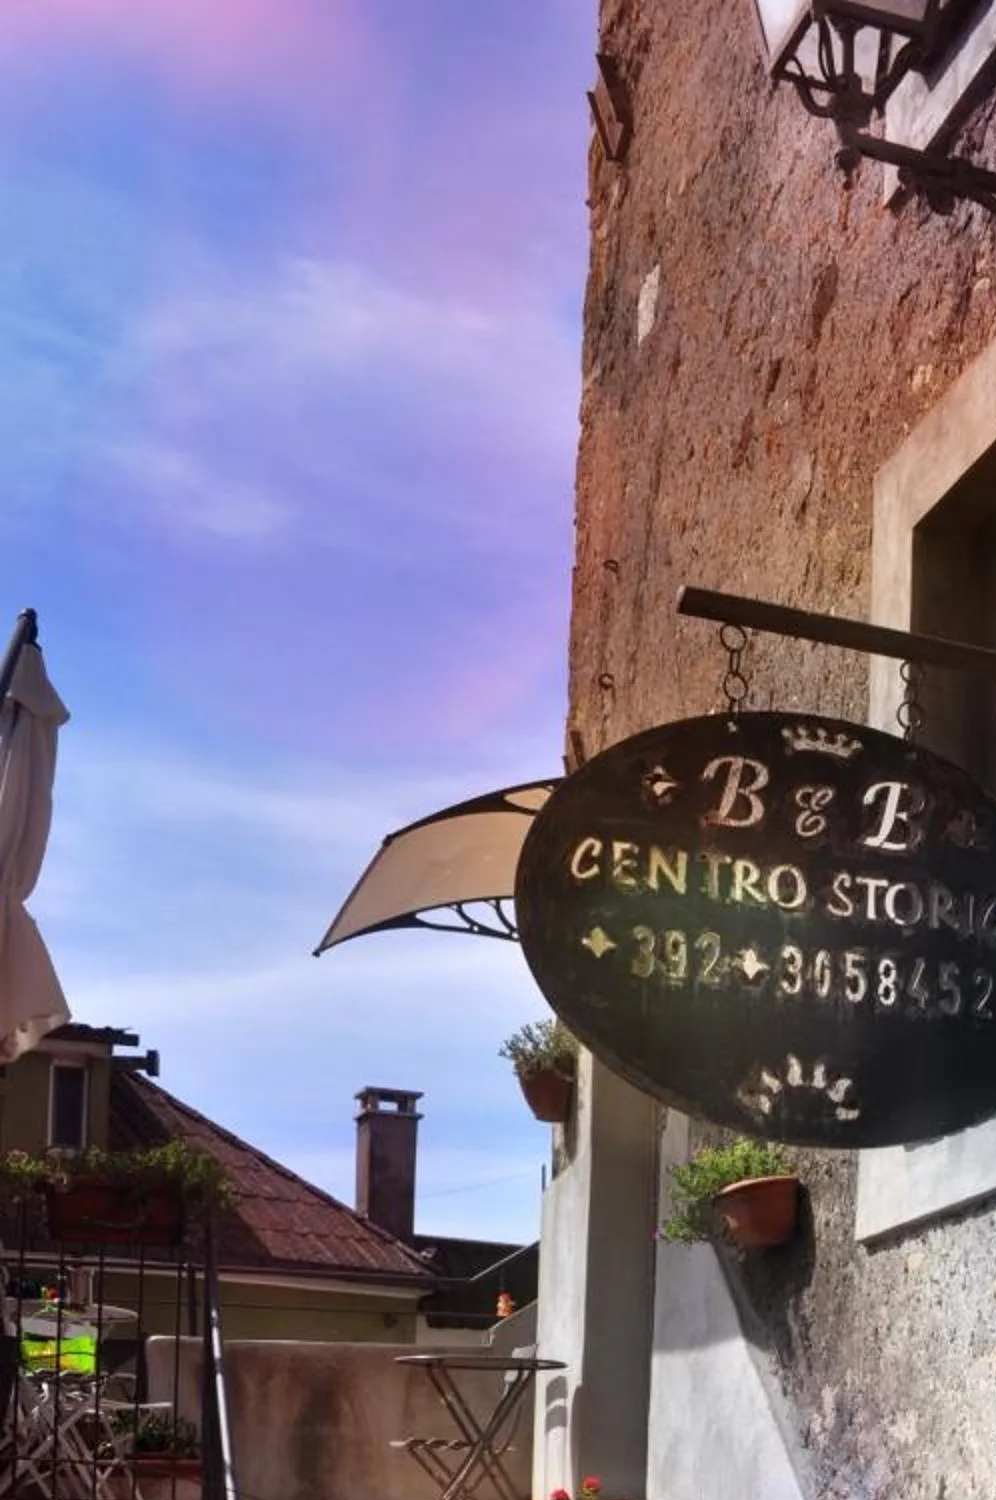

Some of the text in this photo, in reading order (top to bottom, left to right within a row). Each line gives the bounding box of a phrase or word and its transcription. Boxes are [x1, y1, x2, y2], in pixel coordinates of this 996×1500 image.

[700, 756, 926, 851] B & B
[571, 838, 807, 909] CENTRO
[631, 925, 721, 984] 392
